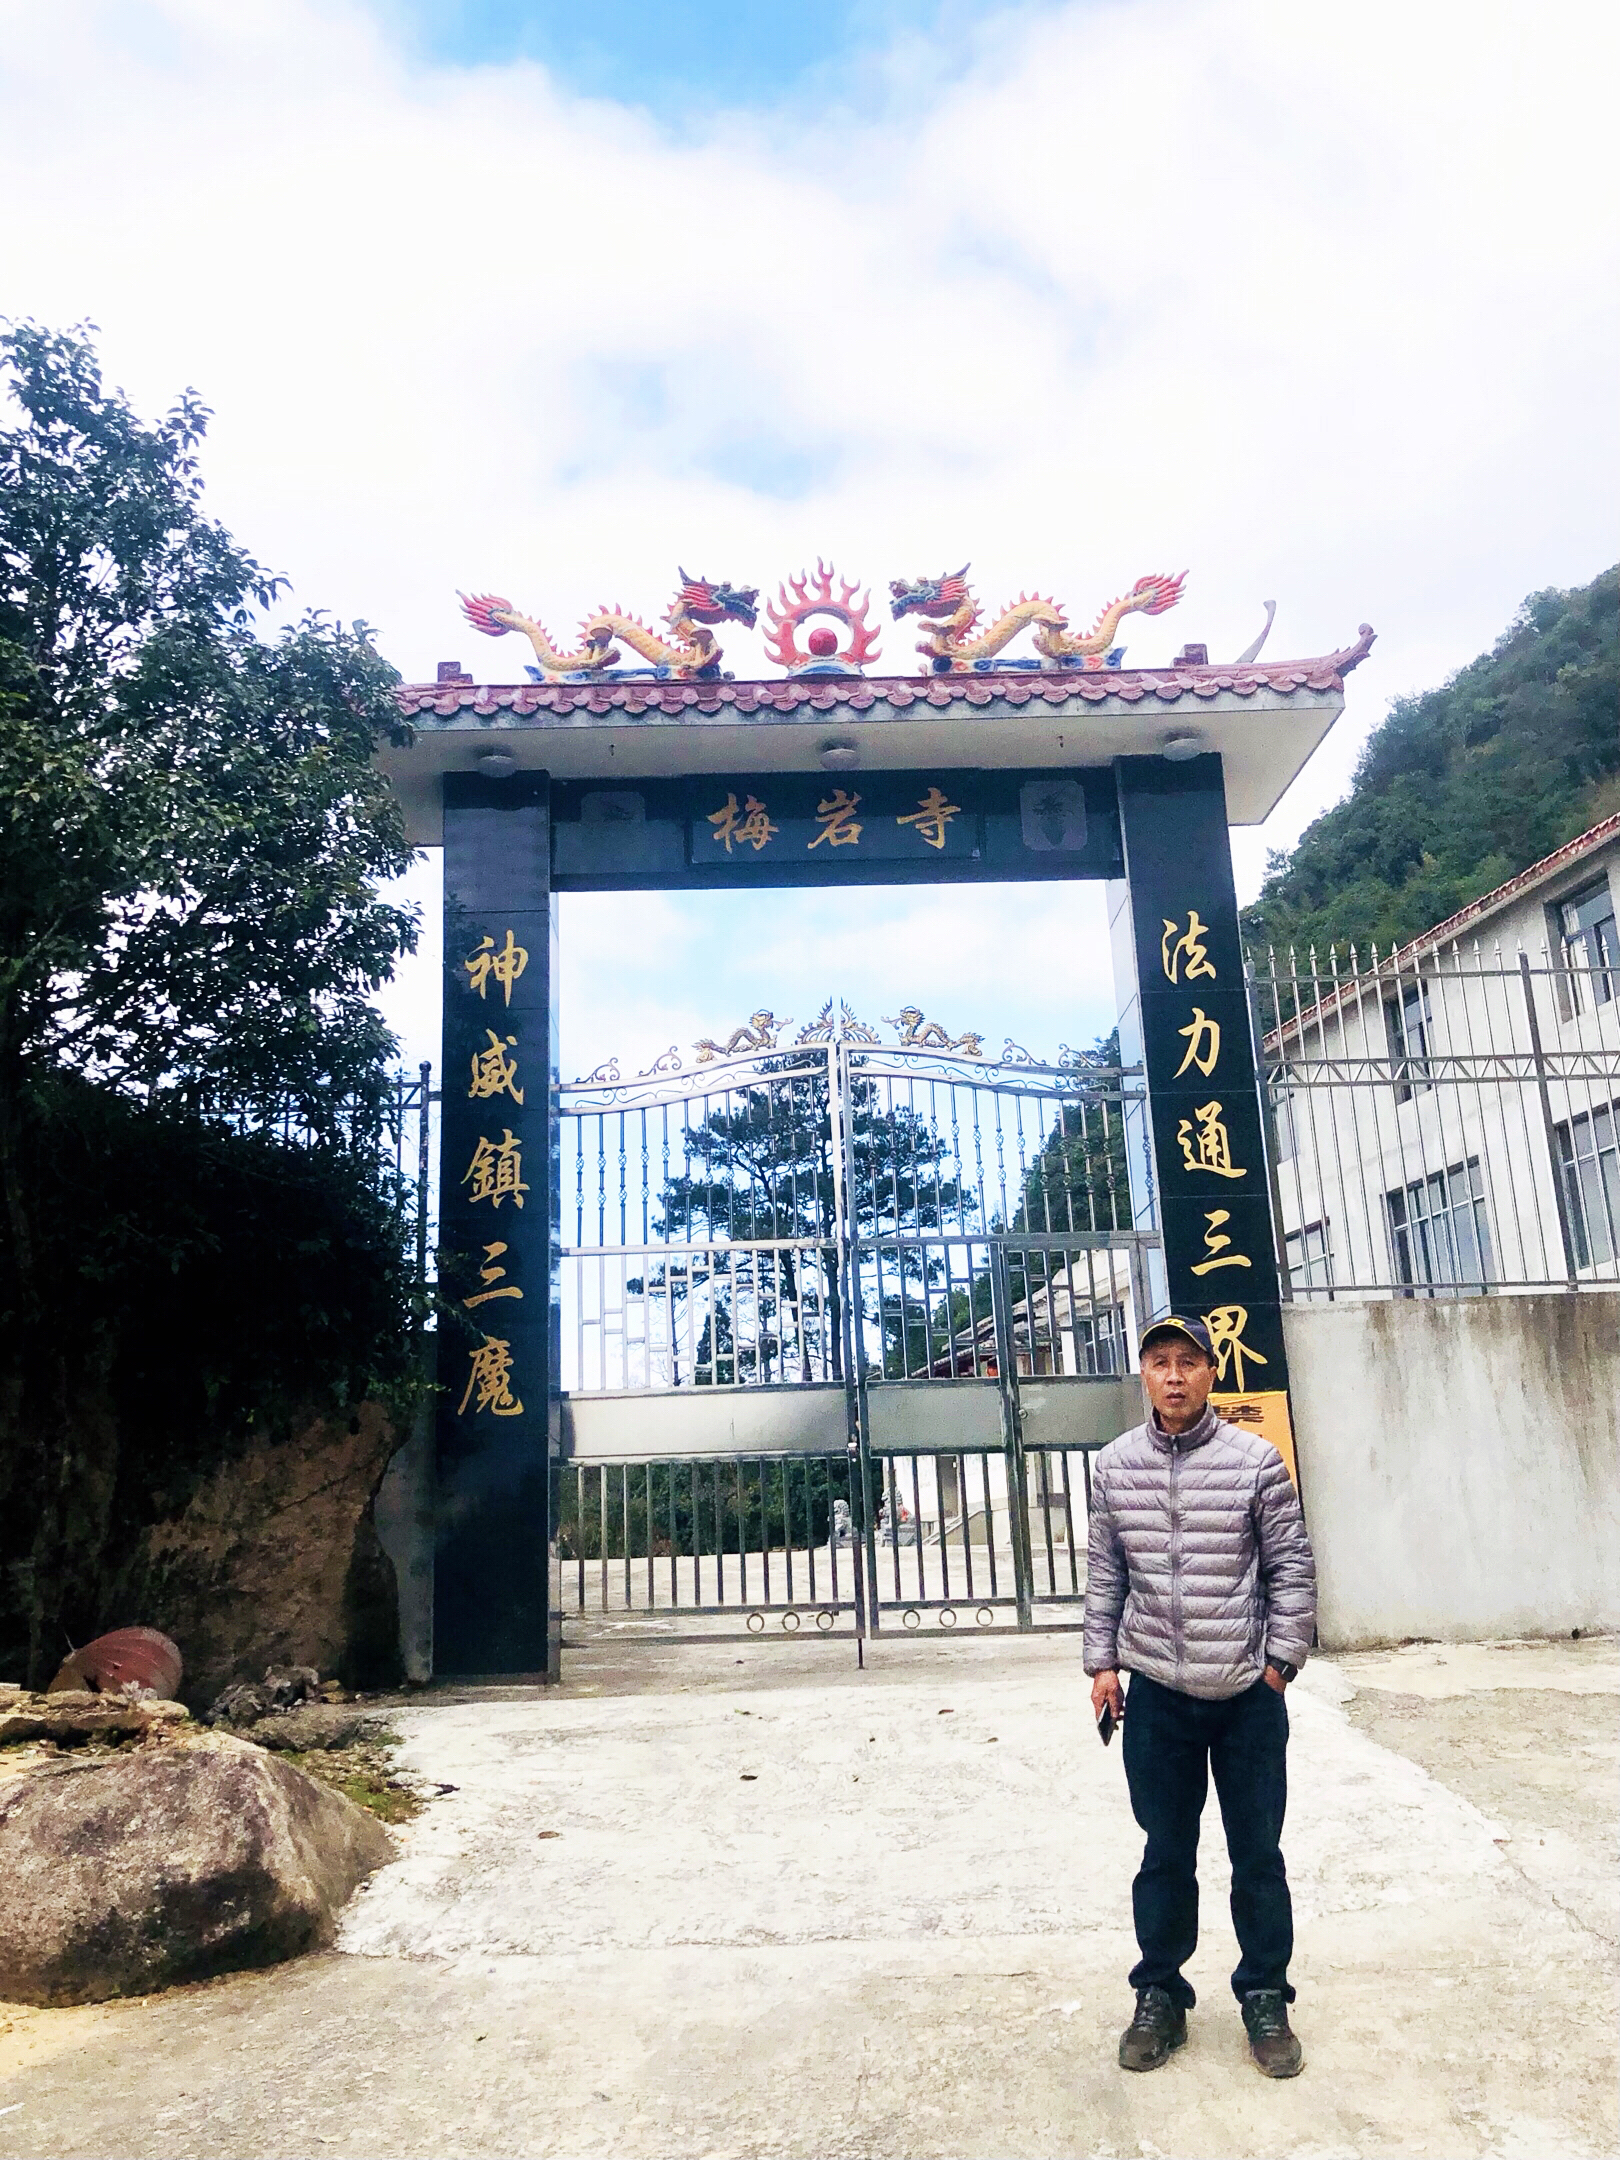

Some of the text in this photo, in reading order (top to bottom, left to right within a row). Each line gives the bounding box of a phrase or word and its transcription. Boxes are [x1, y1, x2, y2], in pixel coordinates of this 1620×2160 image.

[706, 786, 962, 854] 梅岩寺
[458, 929, 531, 1416] 神威鎮三魔
[1161, 910, 1269, 1393] 法力通三界
